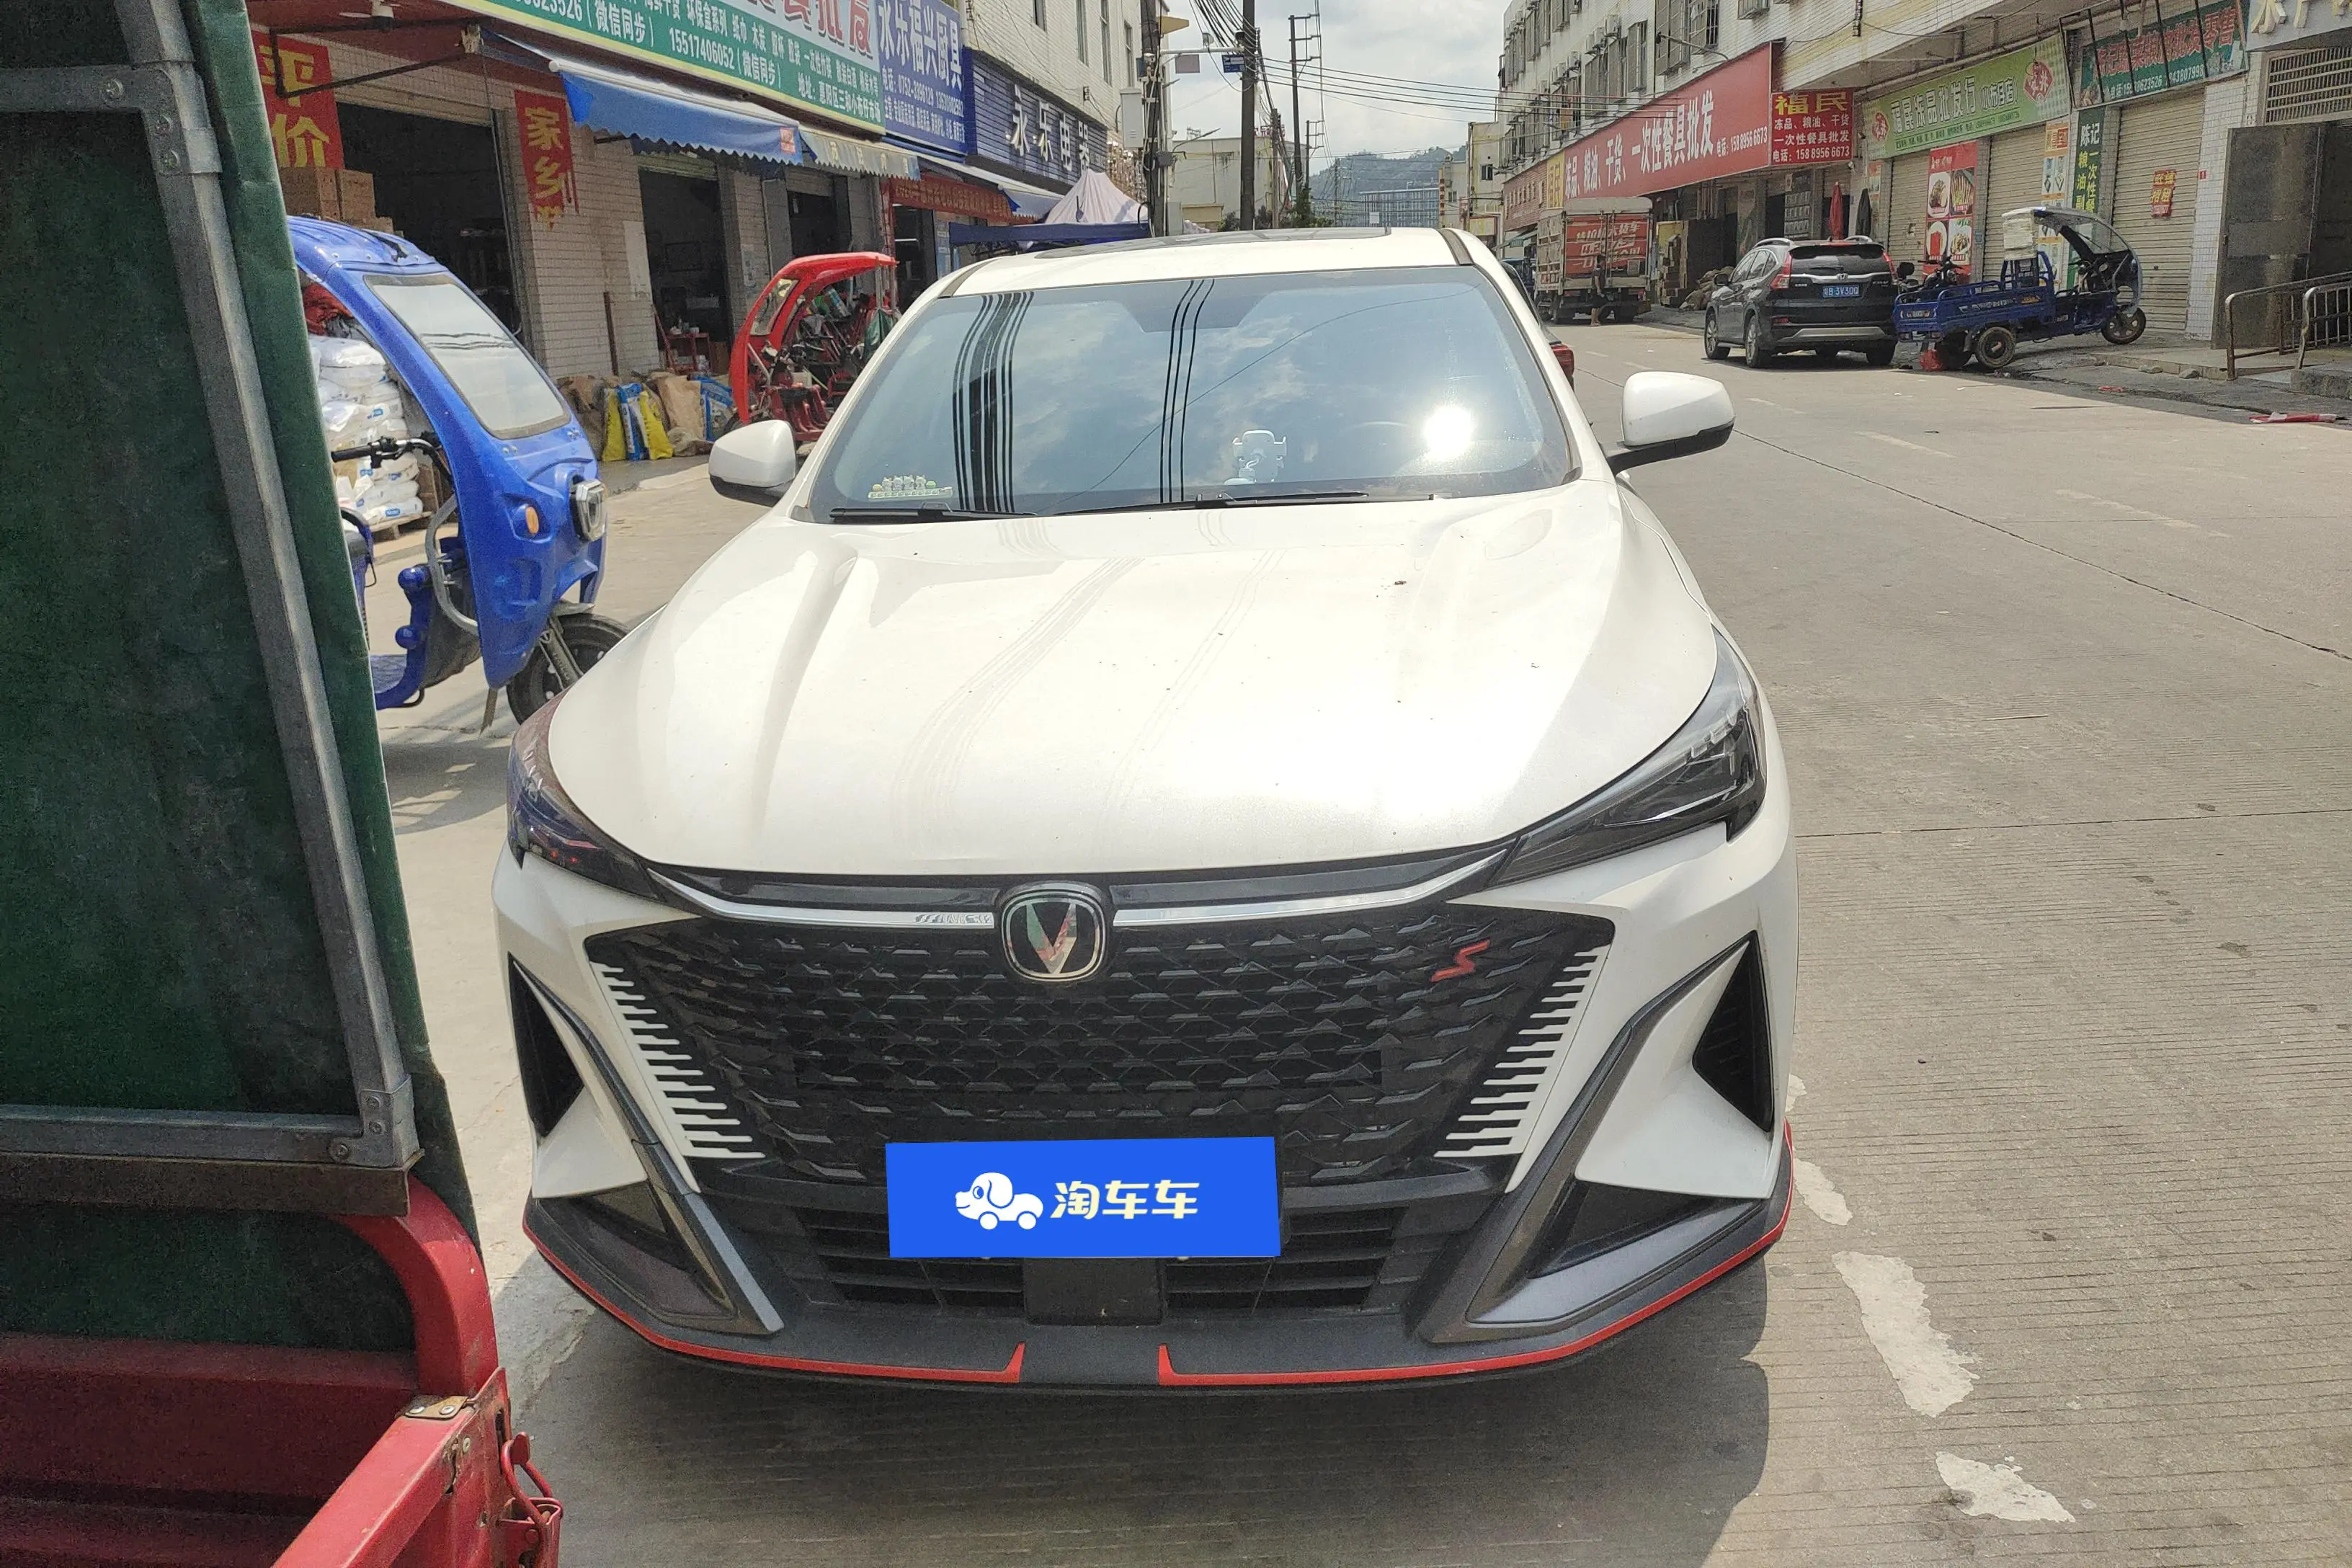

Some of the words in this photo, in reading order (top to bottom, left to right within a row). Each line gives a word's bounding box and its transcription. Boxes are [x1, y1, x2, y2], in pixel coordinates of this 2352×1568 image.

[1775, 91, 1849, 116] 福民
[1773, 130, 1850, 146] 一次性餐具批发
[2080, 122, 2101, 147] 陈记
